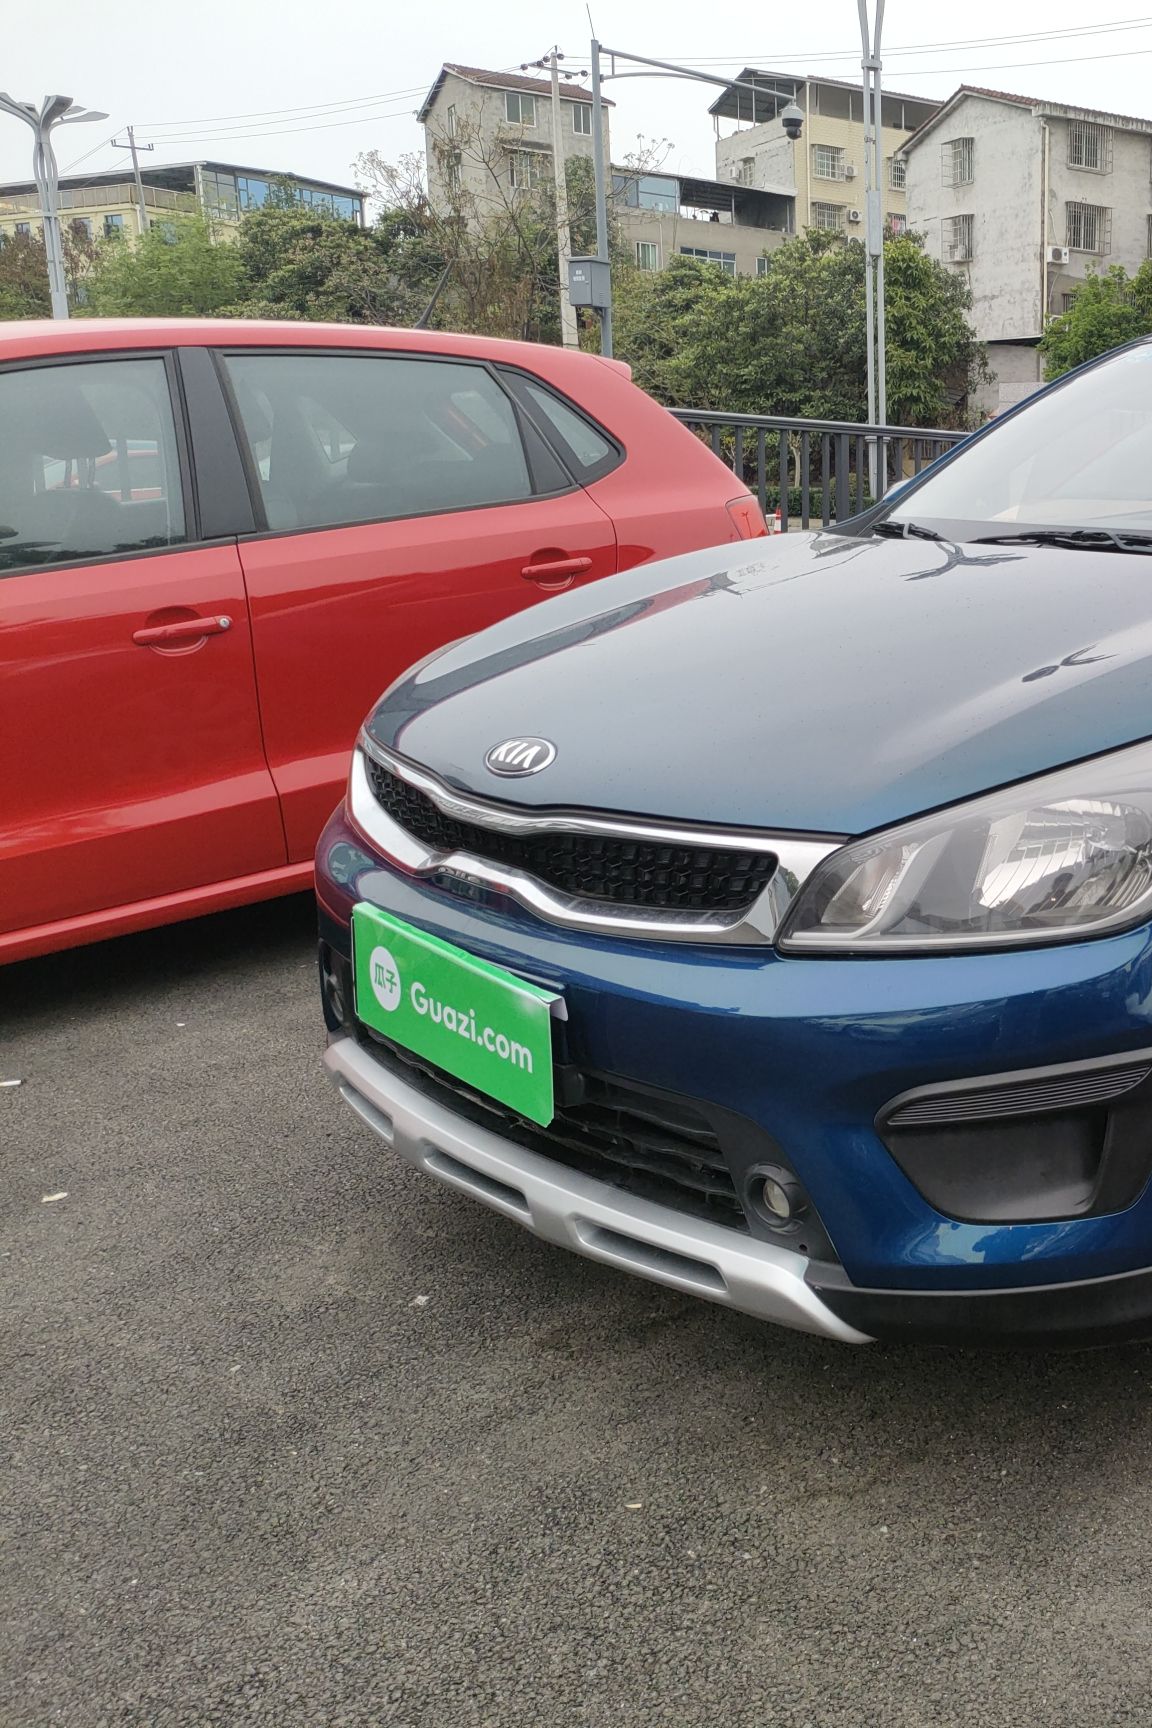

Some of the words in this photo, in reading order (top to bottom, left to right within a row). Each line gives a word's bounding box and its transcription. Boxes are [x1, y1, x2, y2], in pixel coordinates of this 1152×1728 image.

[491, 741, 541, 768] KIA
[374, 962, 398, 994] 瓜子
[410, 981, 533, 1074] Guazi.com
